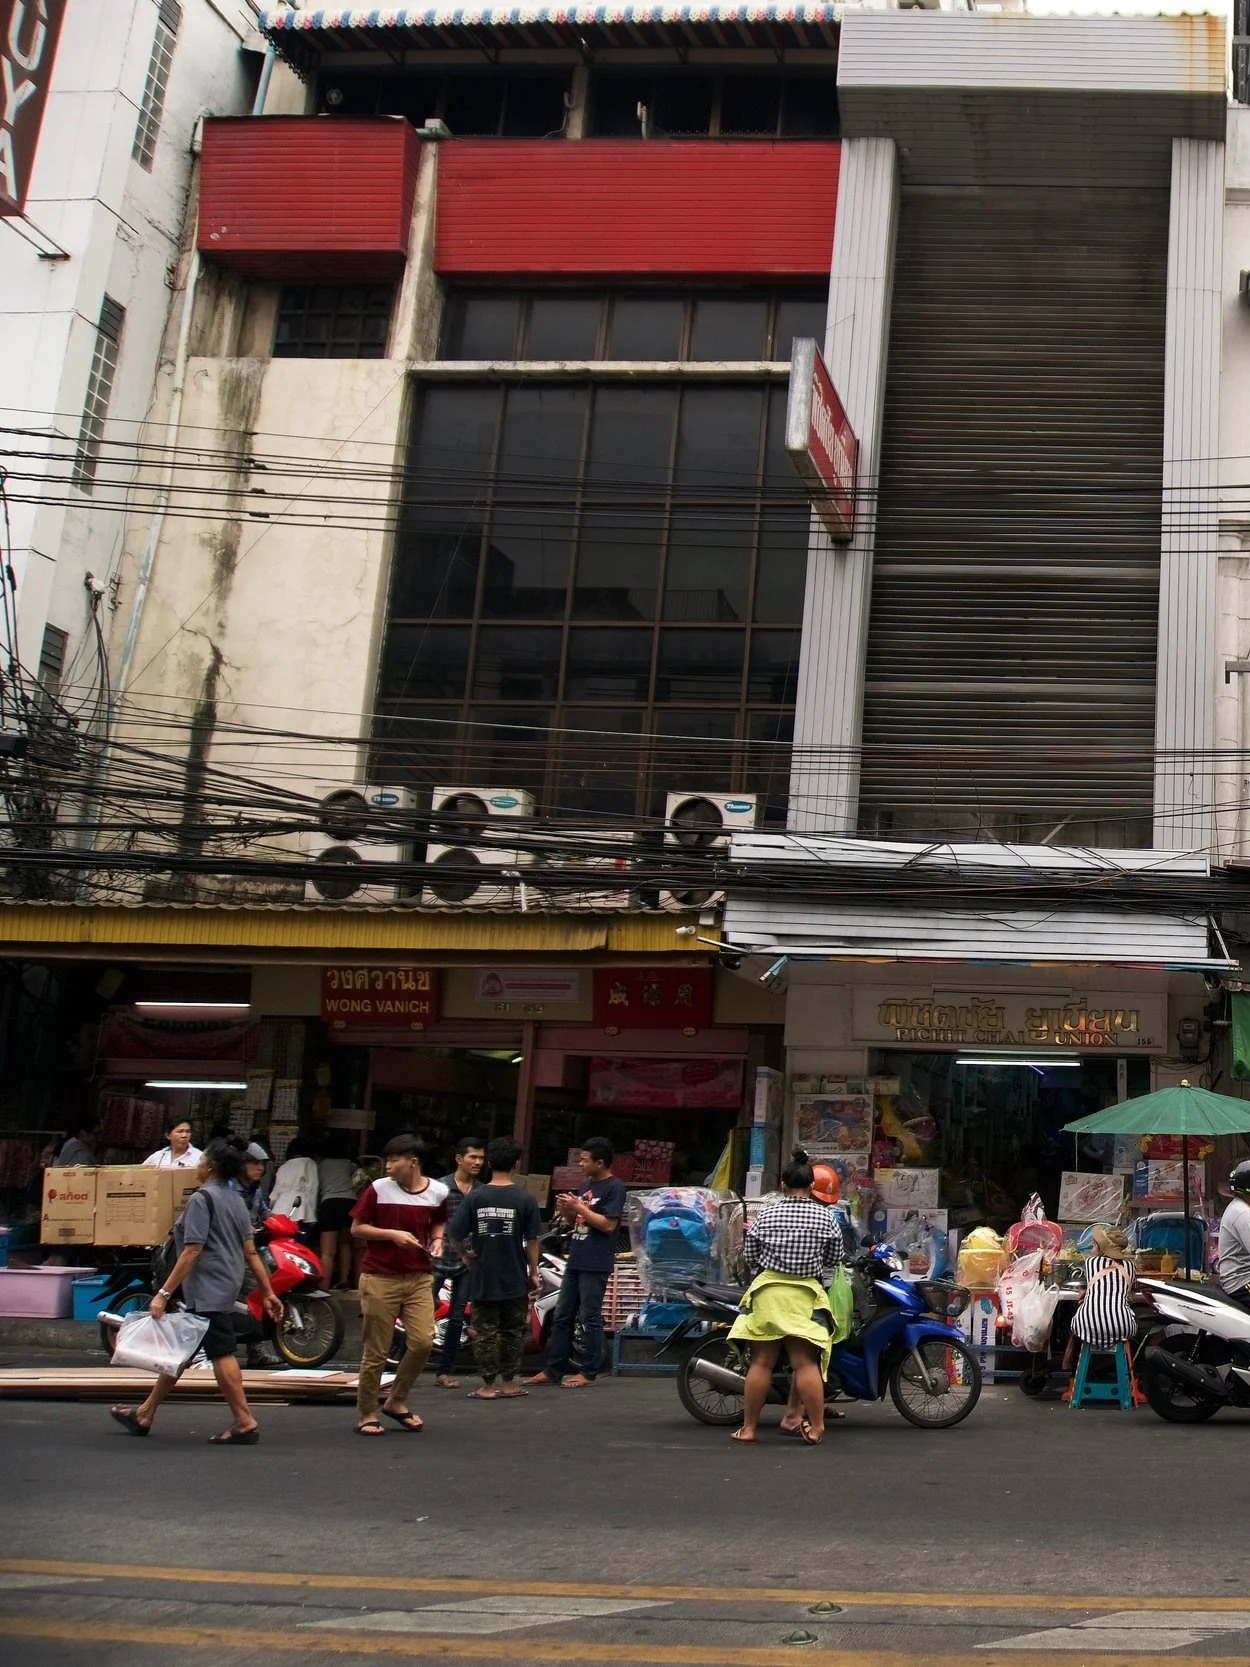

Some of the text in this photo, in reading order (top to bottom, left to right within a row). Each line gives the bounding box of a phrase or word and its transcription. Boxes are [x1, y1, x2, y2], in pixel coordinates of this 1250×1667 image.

[325, 999, 430, 1013] WONG VANICH
[896, 1028, 1118, 1046] PICHIT CHAI UNION
